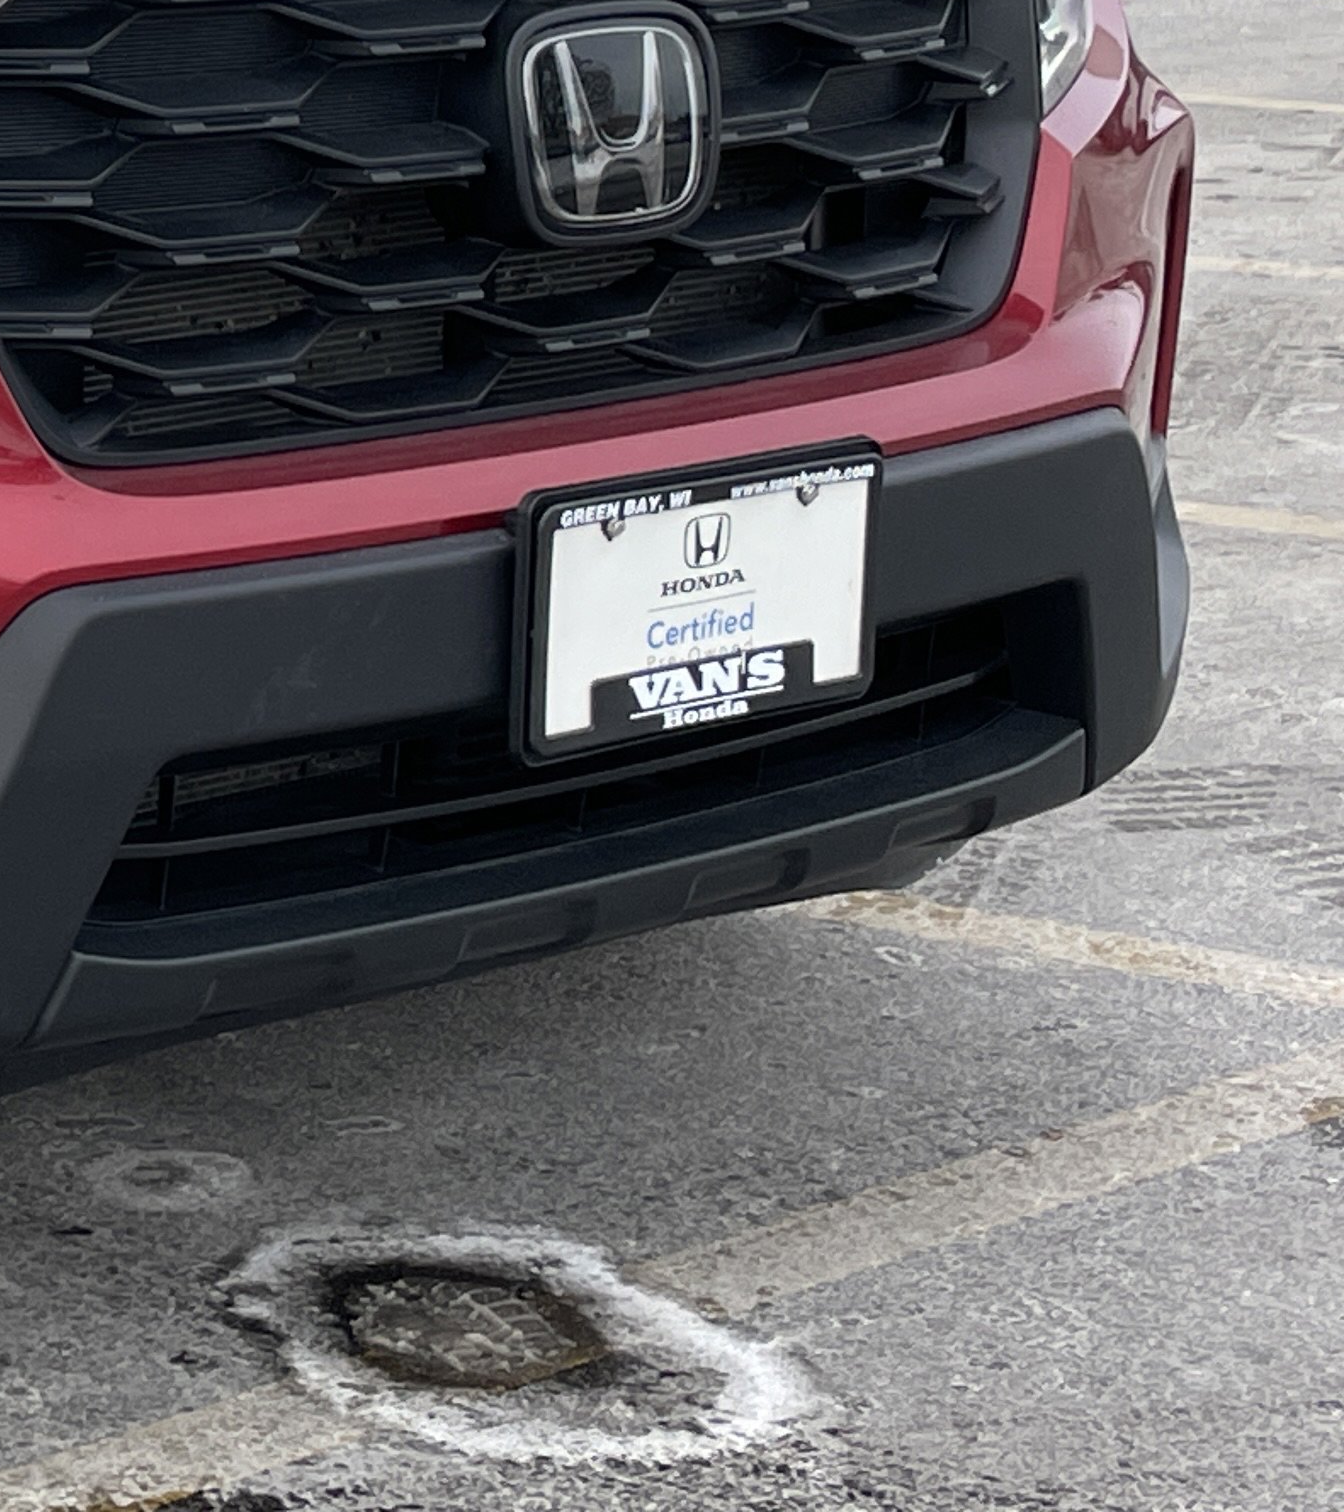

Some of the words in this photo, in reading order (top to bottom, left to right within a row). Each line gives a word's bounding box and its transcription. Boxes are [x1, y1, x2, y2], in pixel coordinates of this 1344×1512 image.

[560, 501, 620, 529] GREEN
[623, 494, 664, 516] BAY,
[669, 489, 693, 509] WI
[660, 568, 746, 597] HONDA
[647, 601, 754, 649] Certified
[662, 698, 749, 730] Honda
